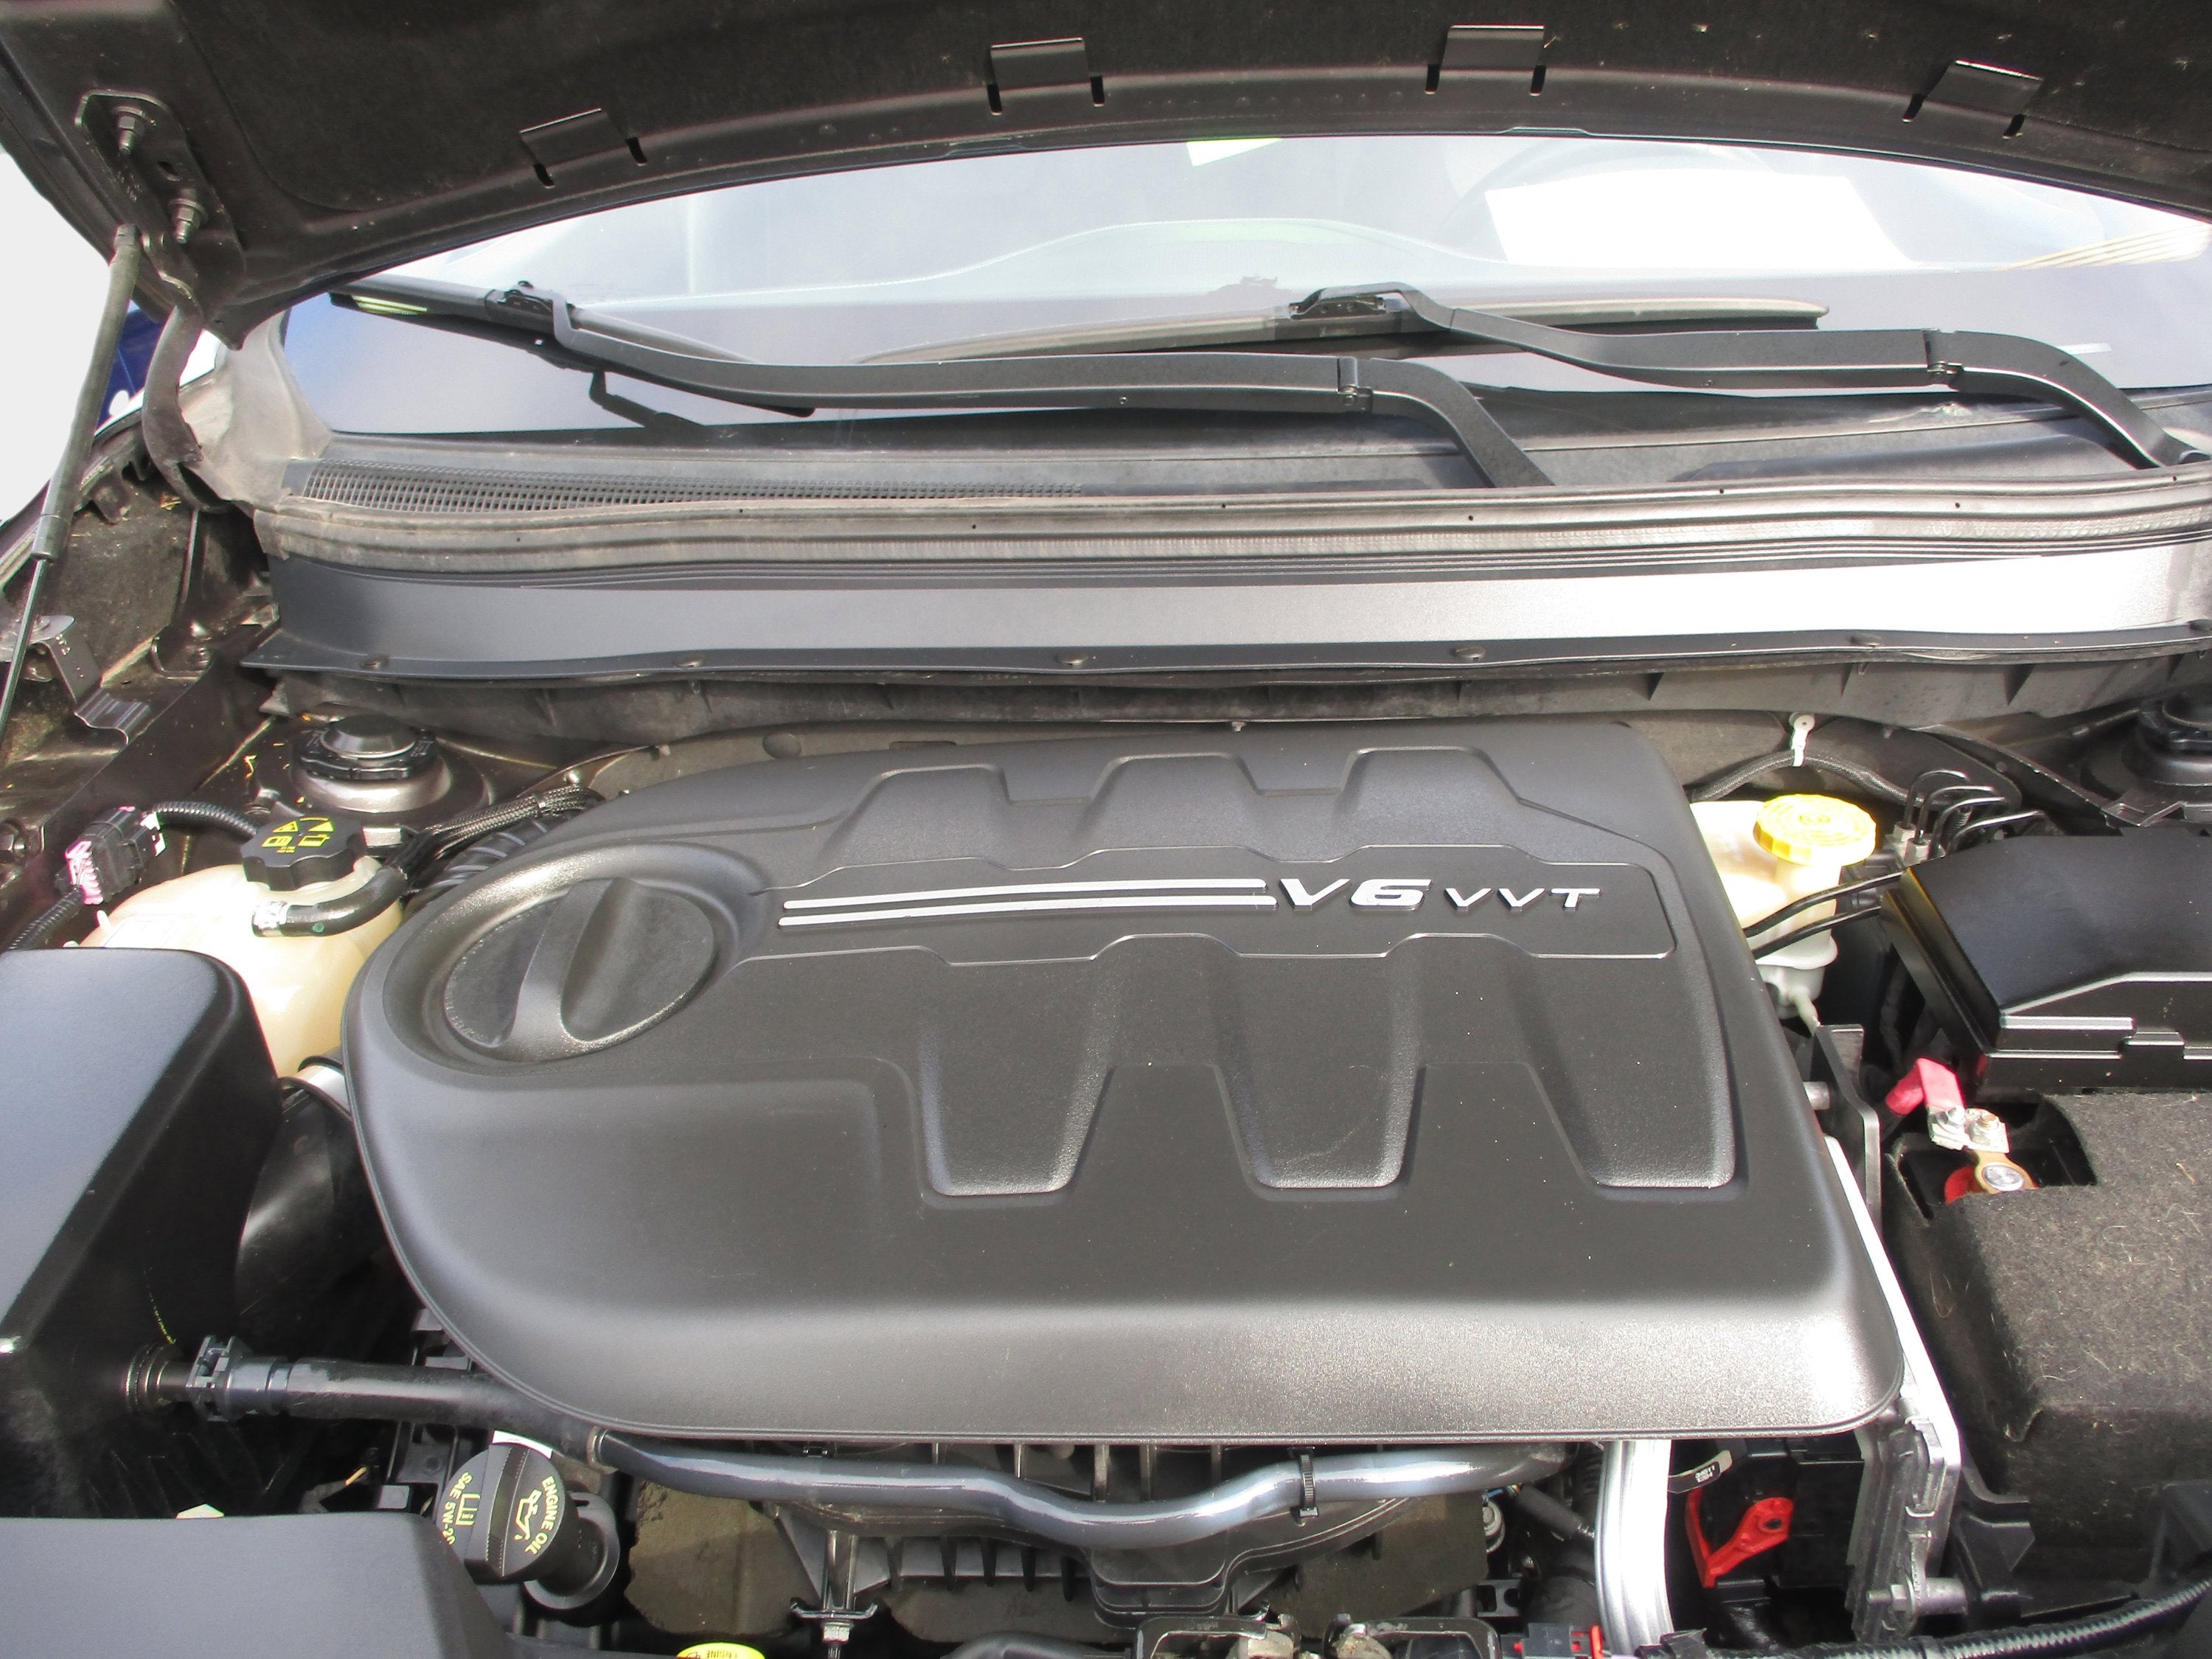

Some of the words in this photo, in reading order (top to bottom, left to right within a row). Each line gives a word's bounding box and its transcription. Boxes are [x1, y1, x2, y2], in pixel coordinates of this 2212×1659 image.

[1279, 878, 1433, 909] V6
[1444, 888, 1601, 911] VVT
[449, 1472, 473, 1499] SAE
[540, 1475, 559, 1531] ENGINE
[525, 1532, 548, 1554] OIL
